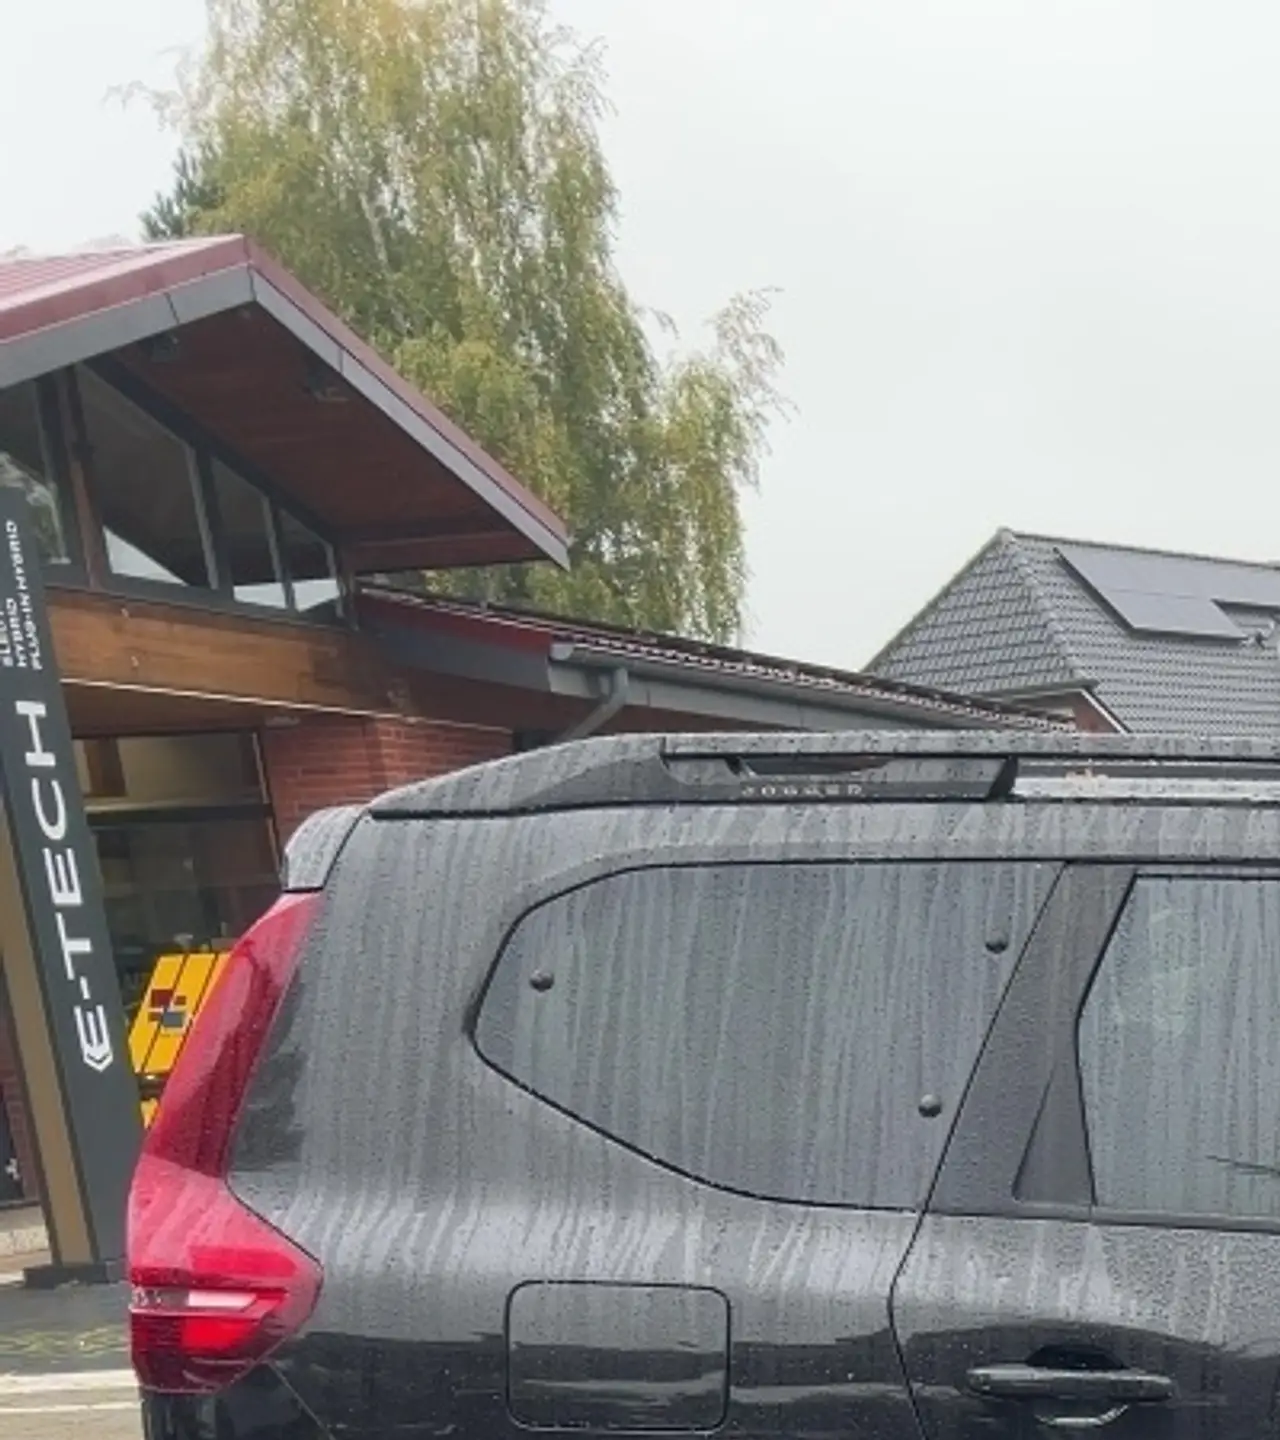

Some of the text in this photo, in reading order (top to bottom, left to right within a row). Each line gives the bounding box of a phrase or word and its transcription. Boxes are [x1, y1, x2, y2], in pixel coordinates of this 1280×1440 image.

[6, 519, 27, 590] HYBRID
[6, 598, 27, 668] HYBRID
[16, 701, 113, 1072] E-TECH
